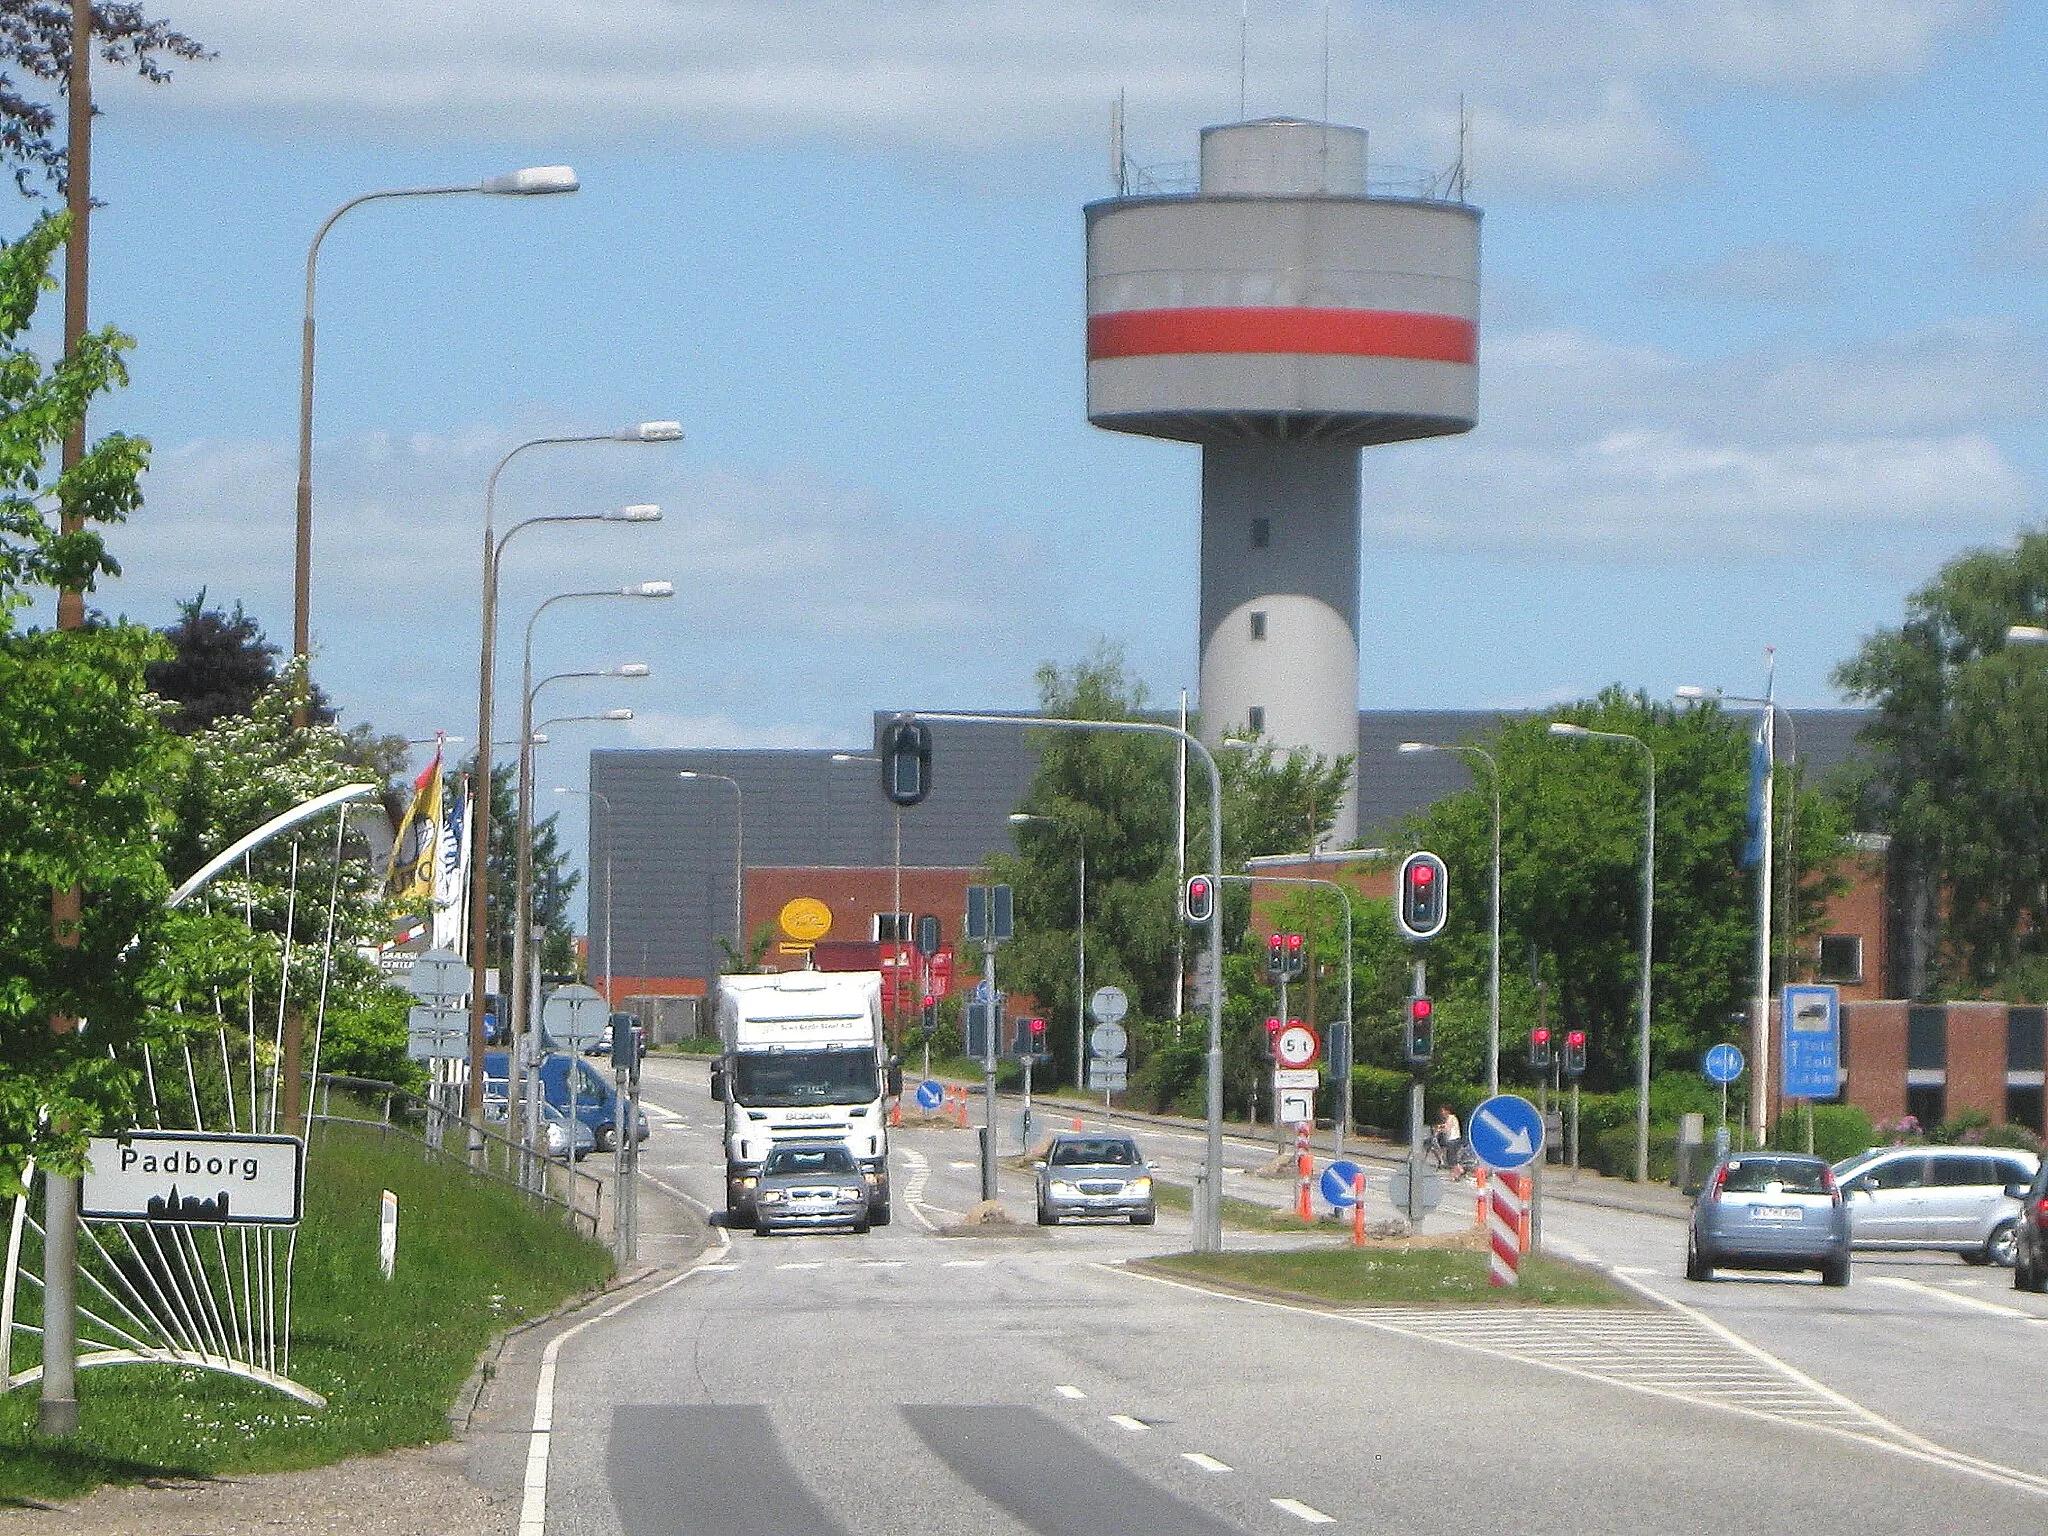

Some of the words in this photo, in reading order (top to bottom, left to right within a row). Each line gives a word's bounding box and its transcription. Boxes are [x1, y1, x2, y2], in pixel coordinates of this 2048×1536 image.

[1286, 1039, 1295, 1052] 5
[1302, 1040, 1308, 1052] t
[121, 1147, 258, 1181] Padborg
